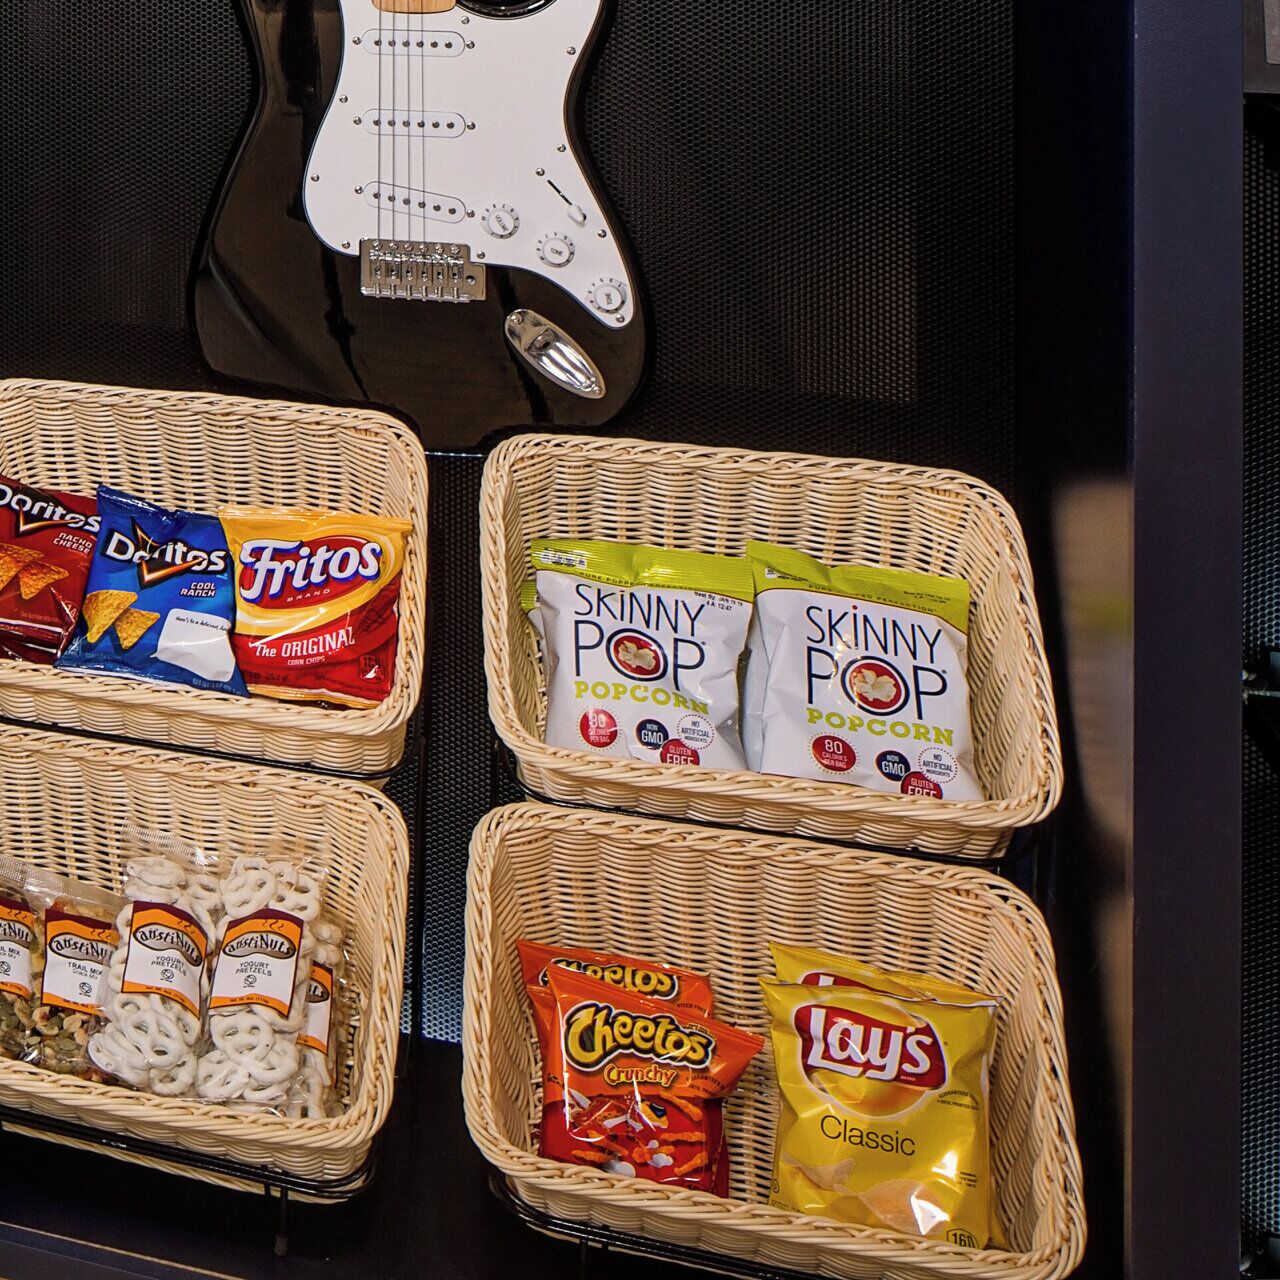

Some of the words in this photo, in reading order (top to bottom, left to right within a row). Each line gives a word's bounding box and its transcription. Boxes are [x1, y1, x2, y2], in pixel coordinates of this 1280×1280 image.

[550, 247, 563, 256] TONE
[53, 538, 91, 554] CHEESE
[58, 532, 93, 549] NACHO
[105, 531, 228, 572] Doritos
[240, 539, 382, 604] Fritos
[180, 588, 216, 597] RANCH
[190, 582, 216, 590] COOL
[286, 588, 331, 603] BRAND
[574, 583, 706, 637] SKINNY
[806, 604, 942, 664] SKINNY
[255, 643, 277, 658] The
[281, 626, 356, 658] ORIGINAL
[287, 657, 305, 666] CORN
[305, 655, 326, 665] CHIPS
[575, 620, 706, 691] POP
[806, 646, 948, 720] POP
[574, 680, 709, 716] POPCORN
[646, 723, 659, 731] NON
[690, 720, 701, 728] NO
[806, 707, 954, 747] POPCORN
[641, 731, 664, 745] GMO
[680, 728, 710, 738] ARTIFICIAL
[669, 745, 692, 756] GLUTEN
[824, 739, 844, 755] 80
[821, 752, 848, 763] CALORIES
[836, 760, 847, 769] BAG
[886, 754, 900, 762] NON
[933, 754, 943, 762] NO
[881, 761, 906, 776] GMO
[922, 761, 953, 772] ARTIFICIAL
[910, 777, 934, 789] GLUTEN
[8, 947, 21, 956] MIX
[68, 961, 87, 972] TRAIL
[90, 967, 103, 976] MIX
[151, 960, 187, 977] PRETZELS
[155, 955, 185, 968] YOGURT
[239, 961, 270, 969] YOGURT
[235, 967, 273, 977] PRETZELS
[566, 1004, 711, 1065] Cheetos
[807, 1007, 933, 1081] Lay's
[604, 1063, 678, 1088] Crunchy
[820, 1114, 916, 1156] Classic
[952, 1231, 975, 1249] 160
